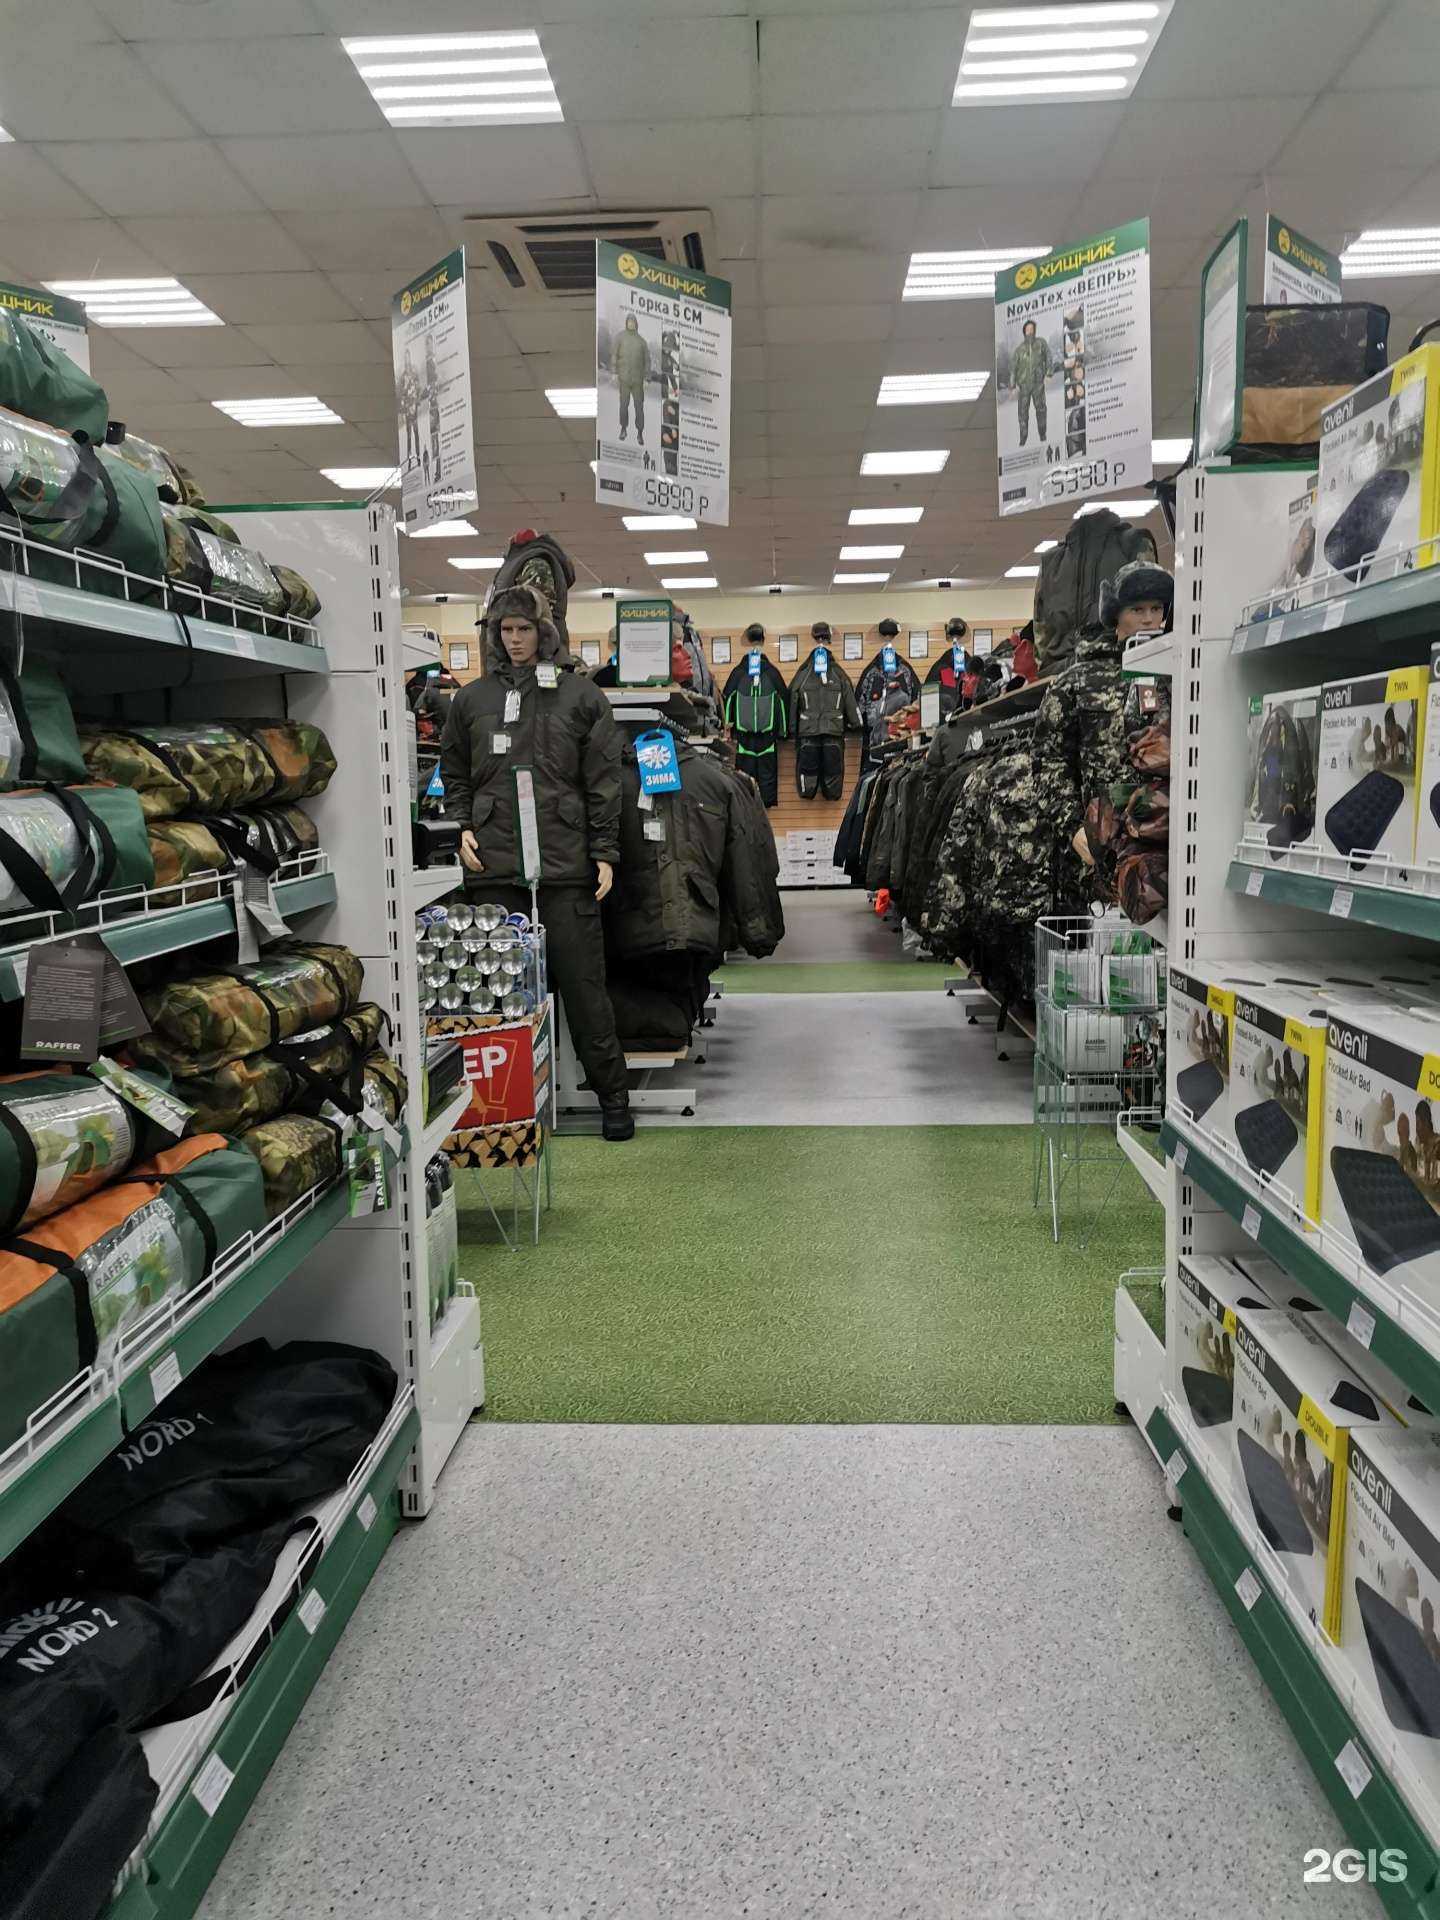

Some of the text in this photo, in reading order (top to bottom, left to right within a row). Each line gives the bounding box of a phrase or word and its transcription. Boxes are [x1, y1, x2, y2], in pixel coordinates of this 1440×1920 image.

[1040, 241, 1115, 279] ХИЩНИК
[641, 266, 706, 298] ХИЩНИК
[1007, 289, 1063, 318] NovaTex
[1068, 268, 1137, 296] «ВЕПРЬ»
[0, 294, 54, 317] ЩНИК
[630, 291, 669, 314] Горка
[673, 304, 680, 318] 5
[1323, 396, 1355, 433] avenli
[645, 478, 694, 512] 5890
[1324, 685, 1352, 708] avenli
[1394, 681, 1408, 692] TWIN
[646, 772, 676, 786] ЗИМА
[1236, 999, 1258, 1025] avenli
[35, 1040, 81, 1050] RAFFER
[1329, 1023, 1368, 1062] avenli
[1349, 1069, 1358, 1084] Air
[1358, 1074, 1371, 1093] Bed
[374, 1155, 385, 1206] RAFFER
[95, 1252, 130, 1289] RAFFER
[1238, 1327, 1266, 1373] avenli
[117, 1412, 215, 1471] NORD 1
[1305, 1410, 1329, 1446] DOUBLE
[1352, 1449, 1392, 1515] avenli
[1382, 1525, 1395, 1551] Bed
[16, 1620, 100, 1673] NORD
[91, 1607, 119, 1628] 2
